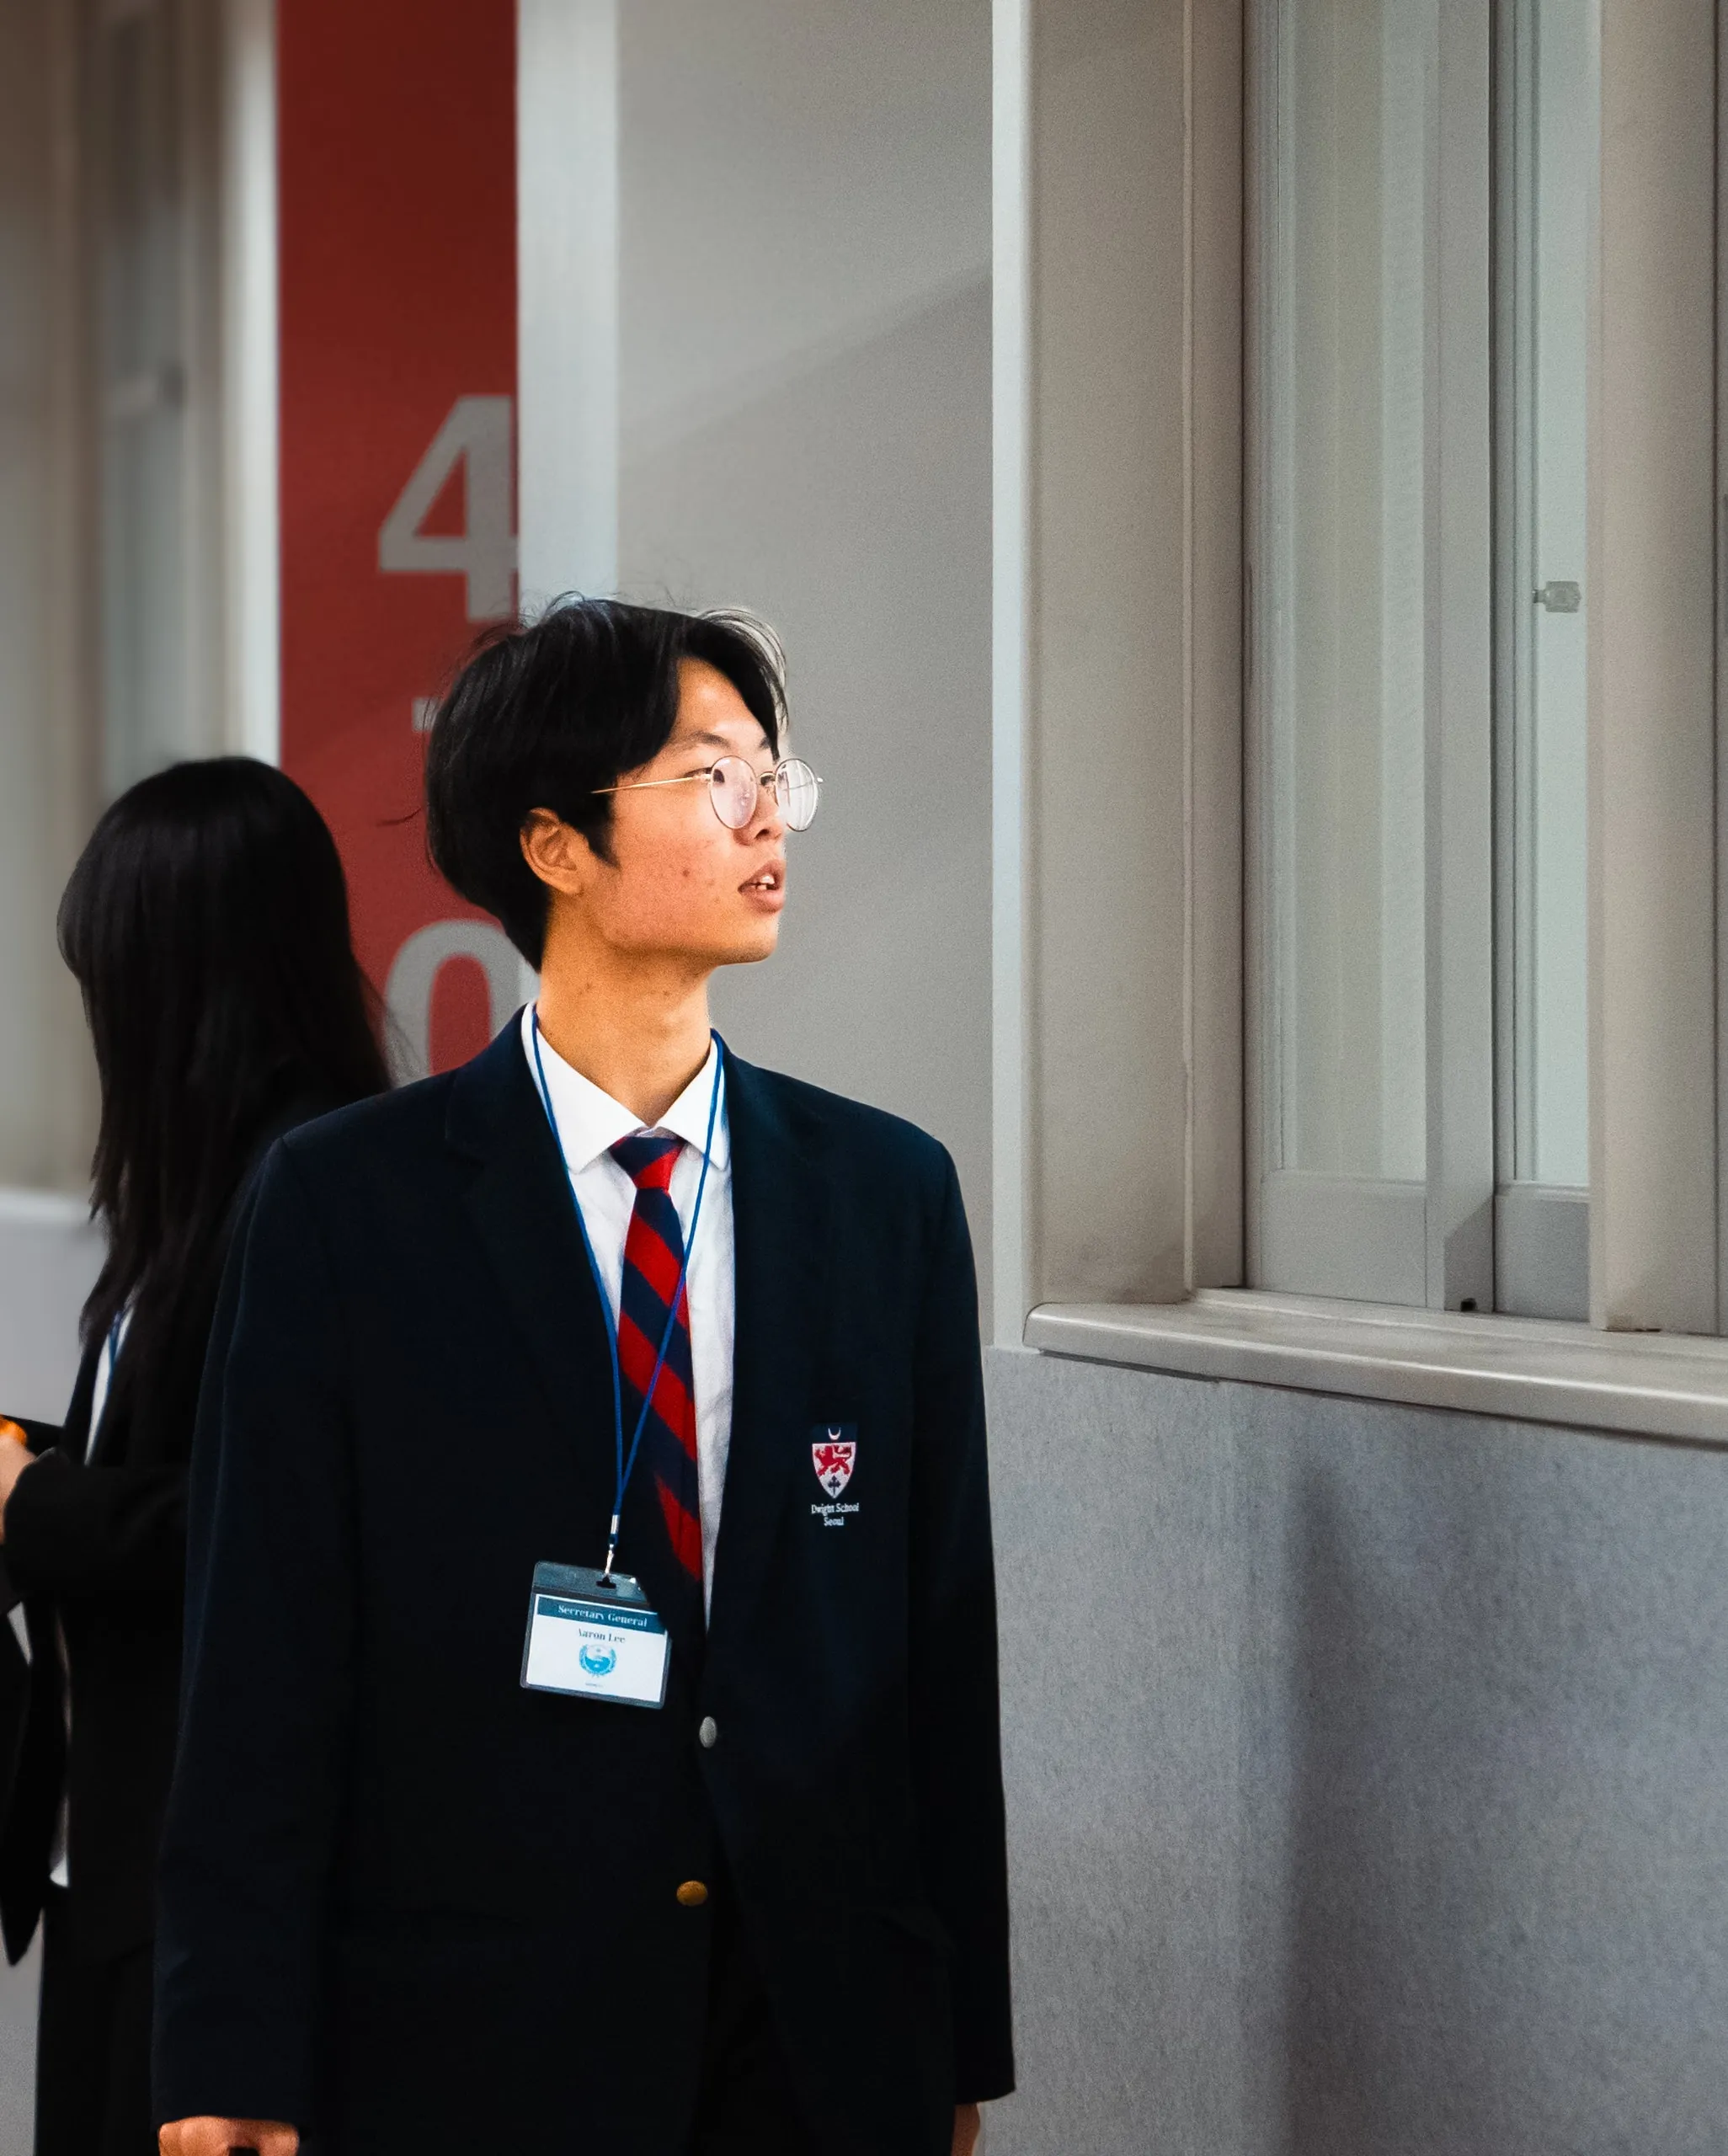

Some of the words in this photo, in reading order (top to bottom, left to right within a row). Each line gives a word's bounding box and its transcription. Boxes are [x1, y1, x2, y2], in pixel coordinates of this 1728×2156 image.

[379, 395, 519, 621] 4
[811, 1503, 835, 1516] Dwight
[835, 1502, 859, 1513] School
[824, 1517, 844, 1526] Seoul
[557, 1604, 605, 1620] Secretary
[608, 1612, 648, 1627] General
[579, 1628, 605, 1641] Aaron
[608, 1632, 626, 1643] Lee
